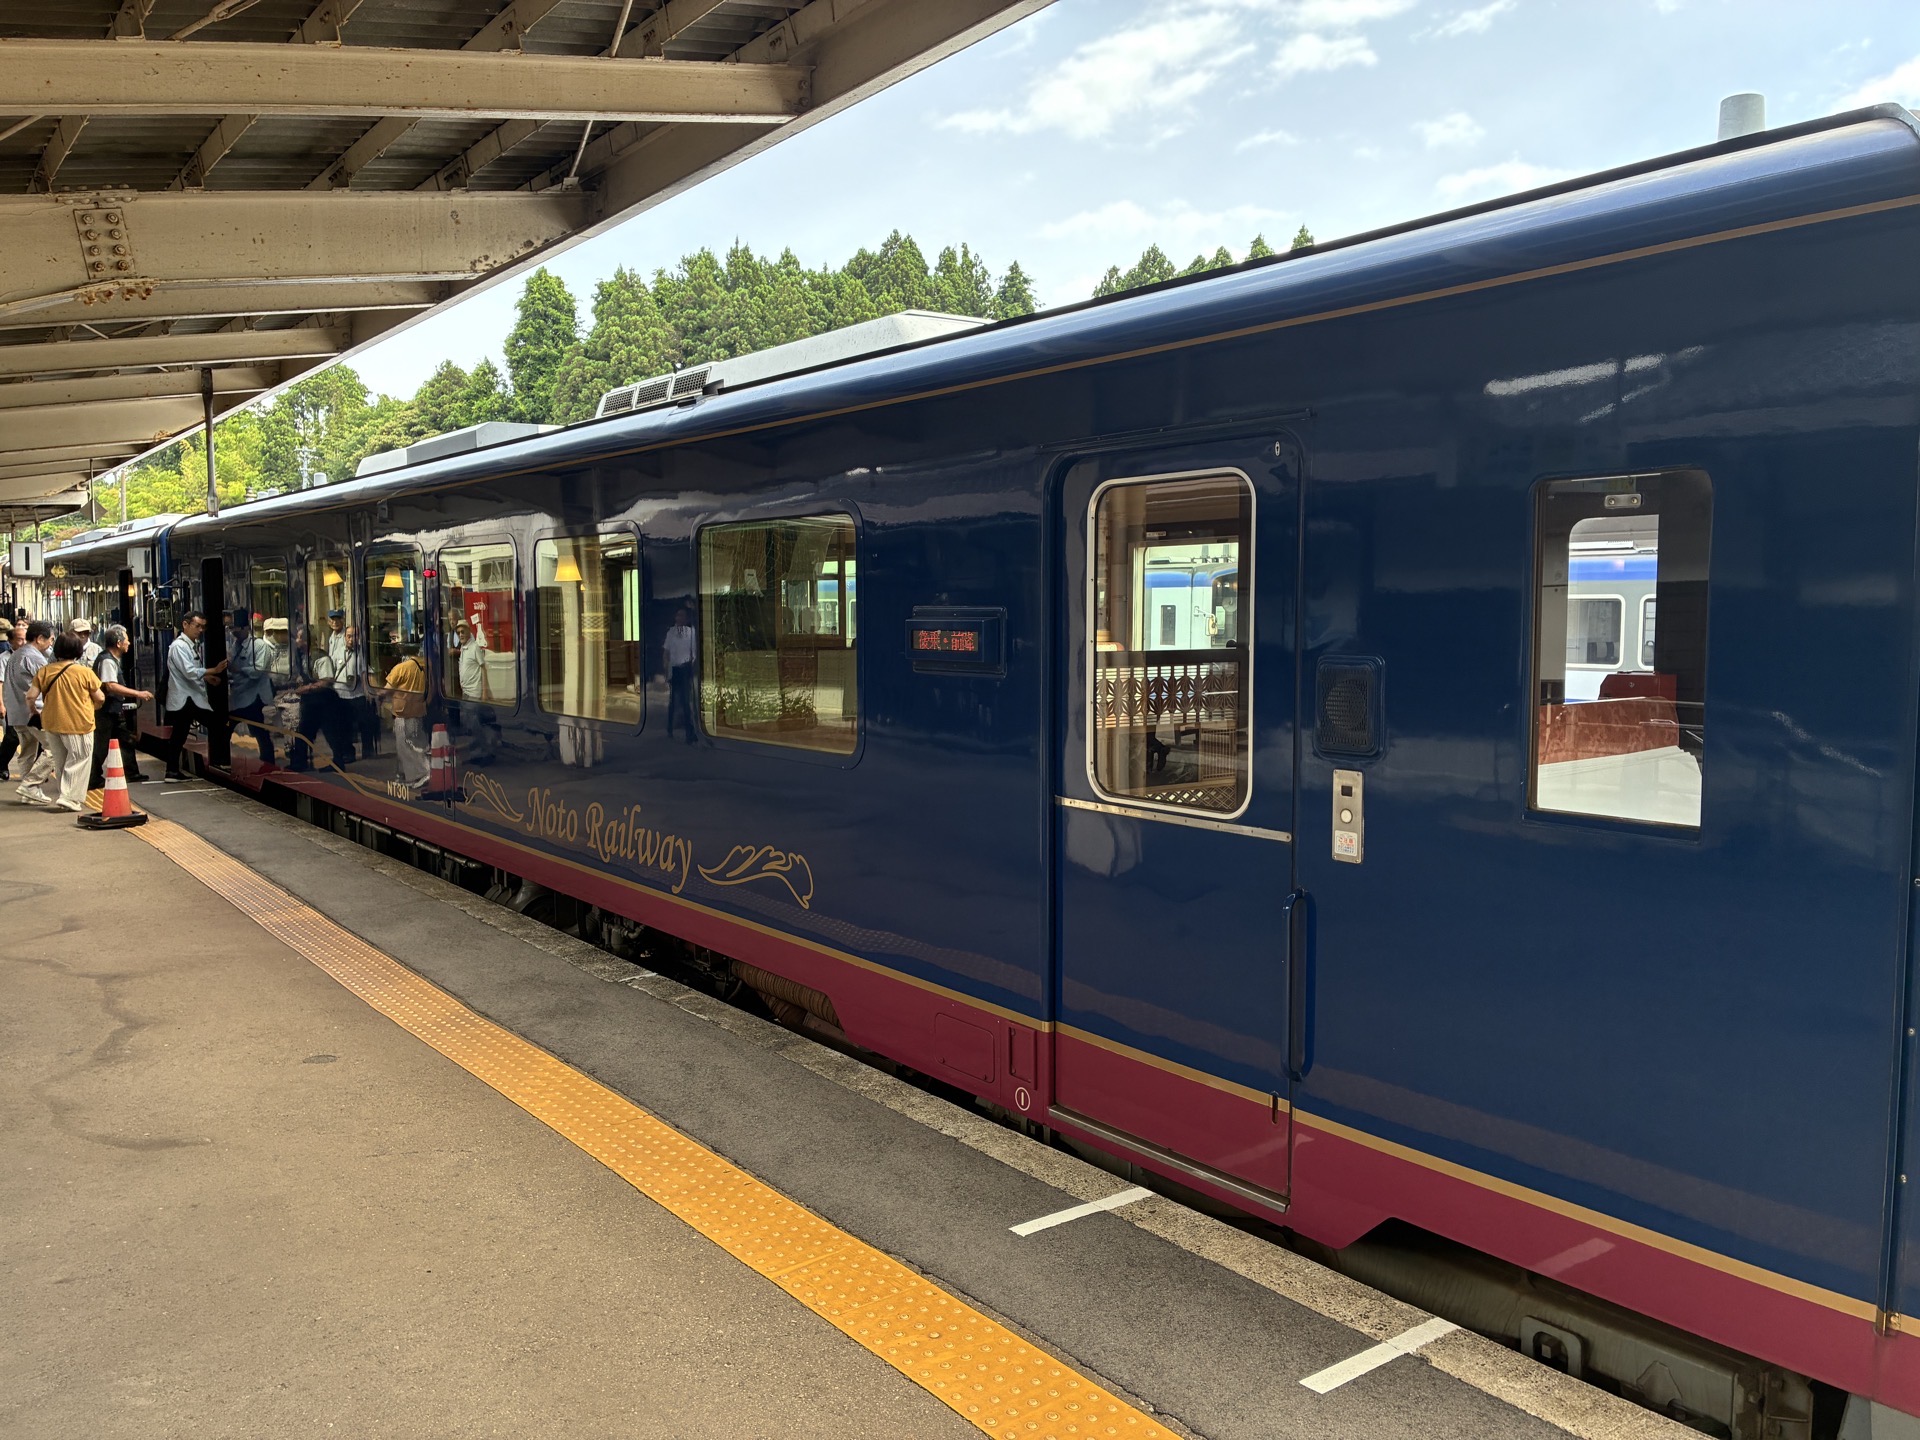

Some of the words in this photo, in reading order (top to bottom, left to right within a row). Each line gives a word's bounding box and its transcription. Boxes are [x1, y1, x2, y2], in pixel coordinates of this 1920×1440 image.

[387, 780, 410, 801] NT301
[526, 787, 578, 842] Noto
[585, 802, 692, 894] Railway
